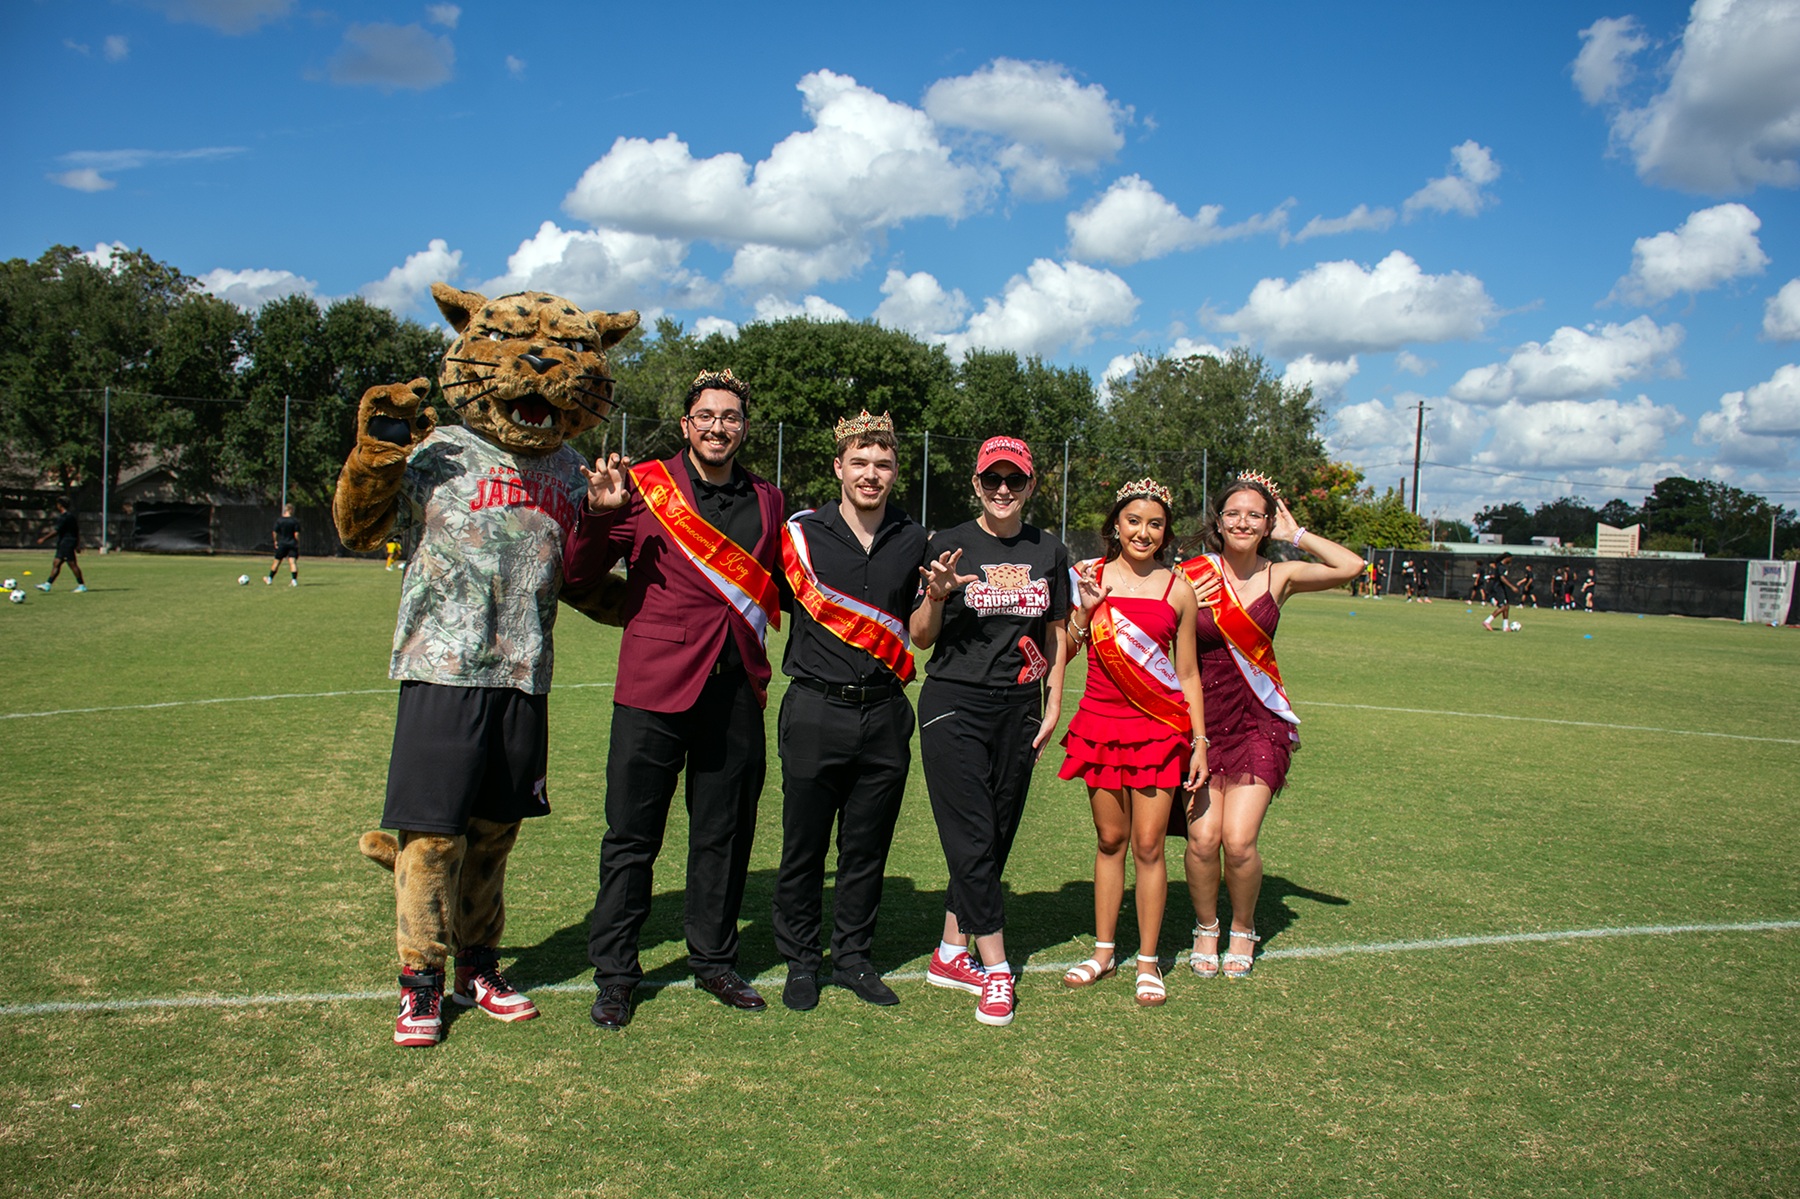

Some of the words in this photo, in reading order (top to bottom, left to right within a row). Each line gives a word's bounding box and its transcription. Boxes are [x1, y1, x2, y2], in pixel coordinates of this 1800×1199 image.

[666, 507, 718, 560] Homecoming
[719, 552, 749, 580] King
[974, 594, 1019, 607] CRUSH
[980, 605, 1042, 615] HOMECOMING
[854, 622, 885, 646] Prie
[1154, 657, 1176, 682] Court
